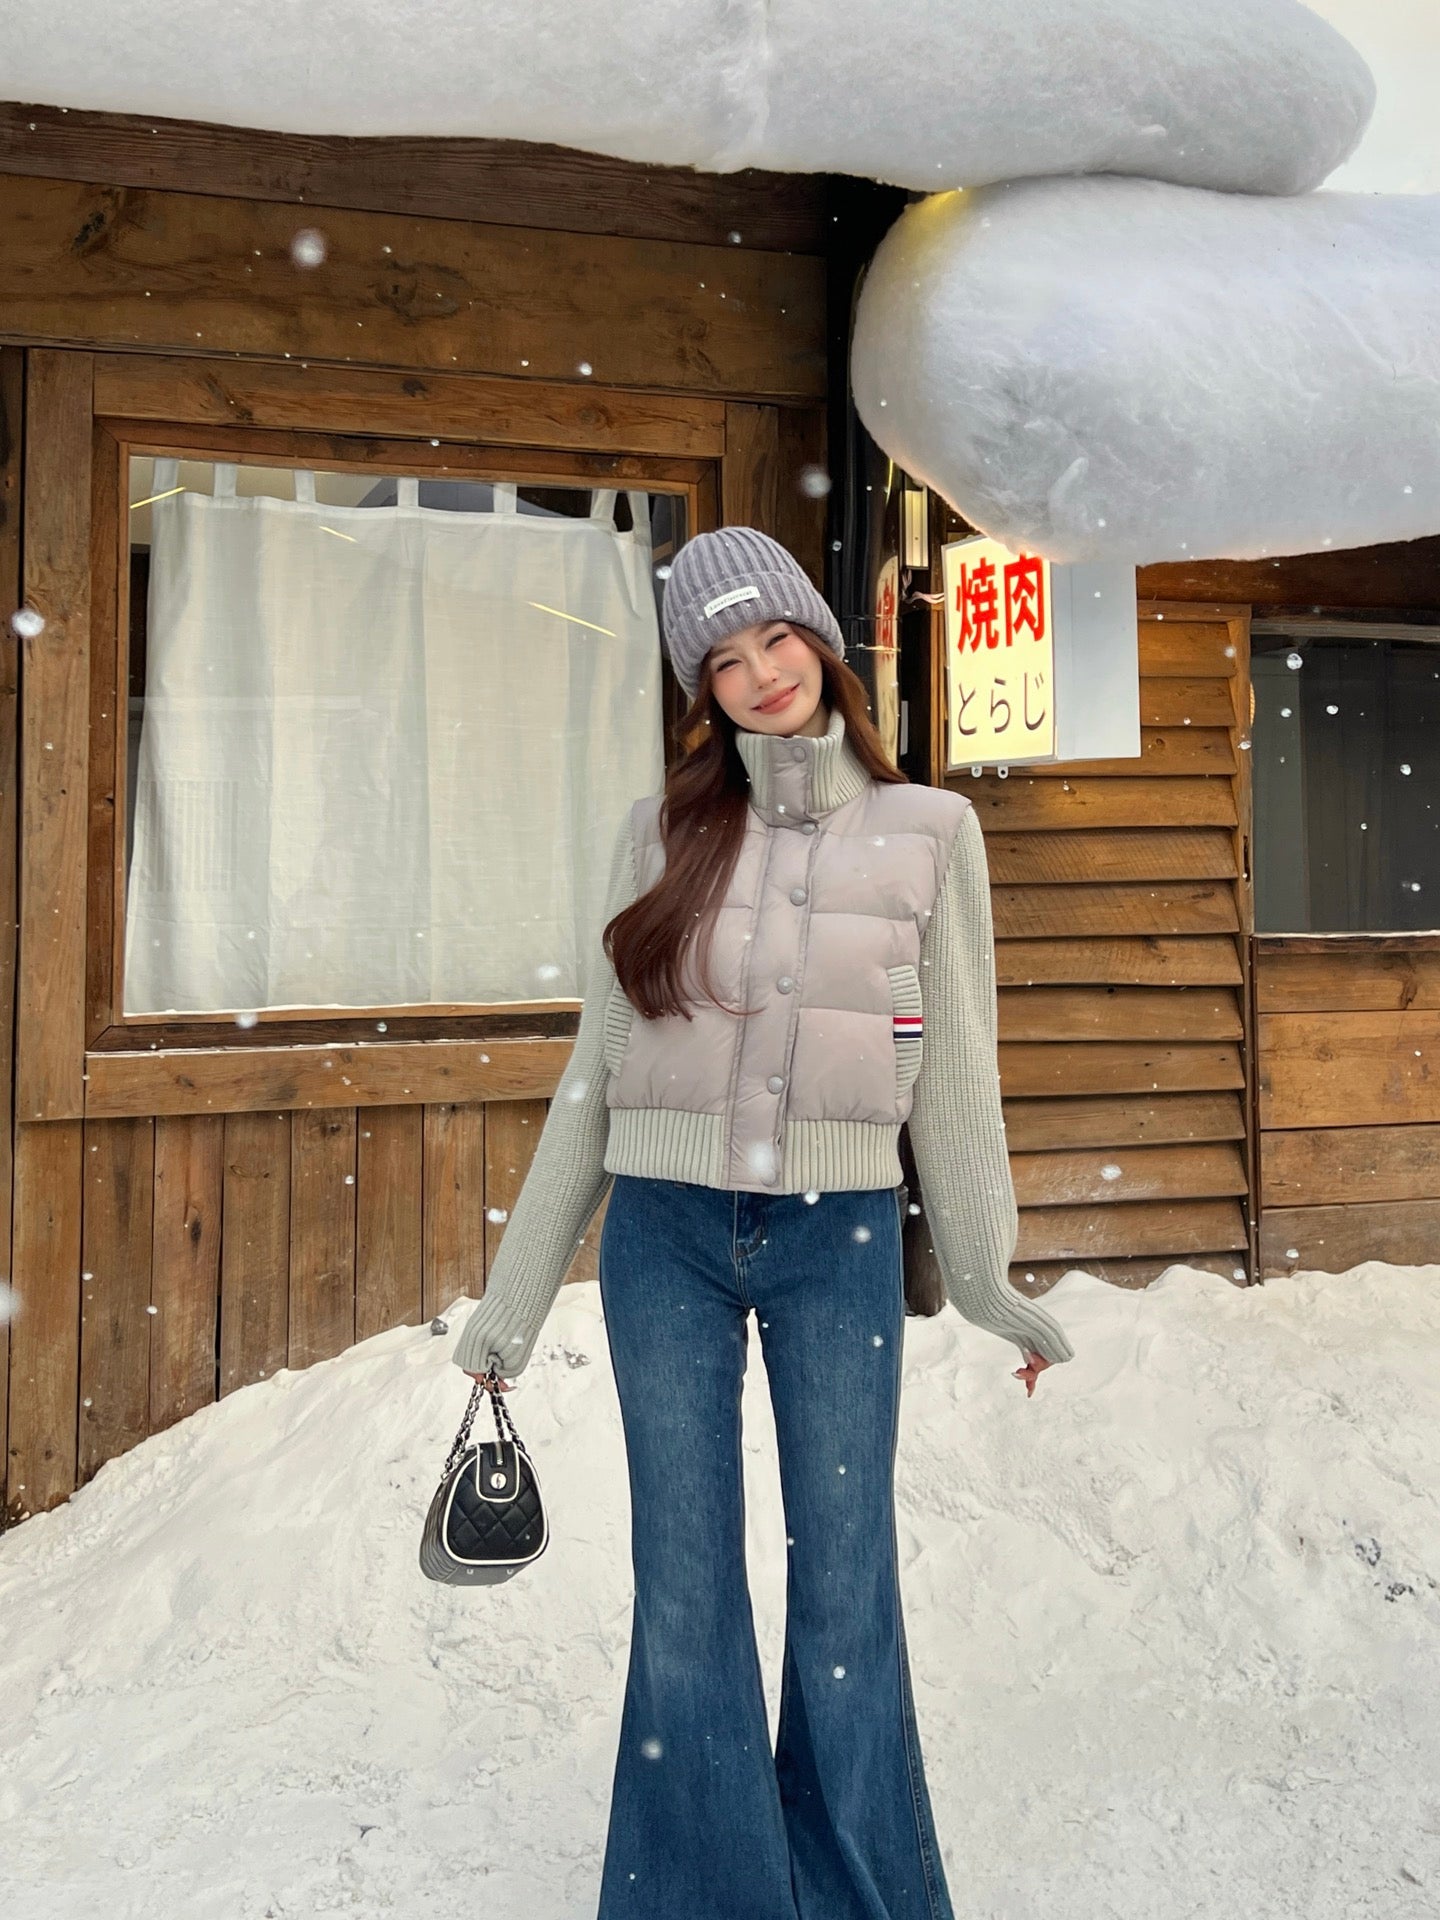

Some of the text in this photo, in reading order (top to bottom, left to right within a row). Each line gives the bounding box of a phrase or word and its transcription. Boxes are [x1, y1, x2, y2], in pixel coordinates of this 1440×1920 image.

[956, 552, 1045, 654] 焼肉
[957, 672, 1046, 735] とらじ
